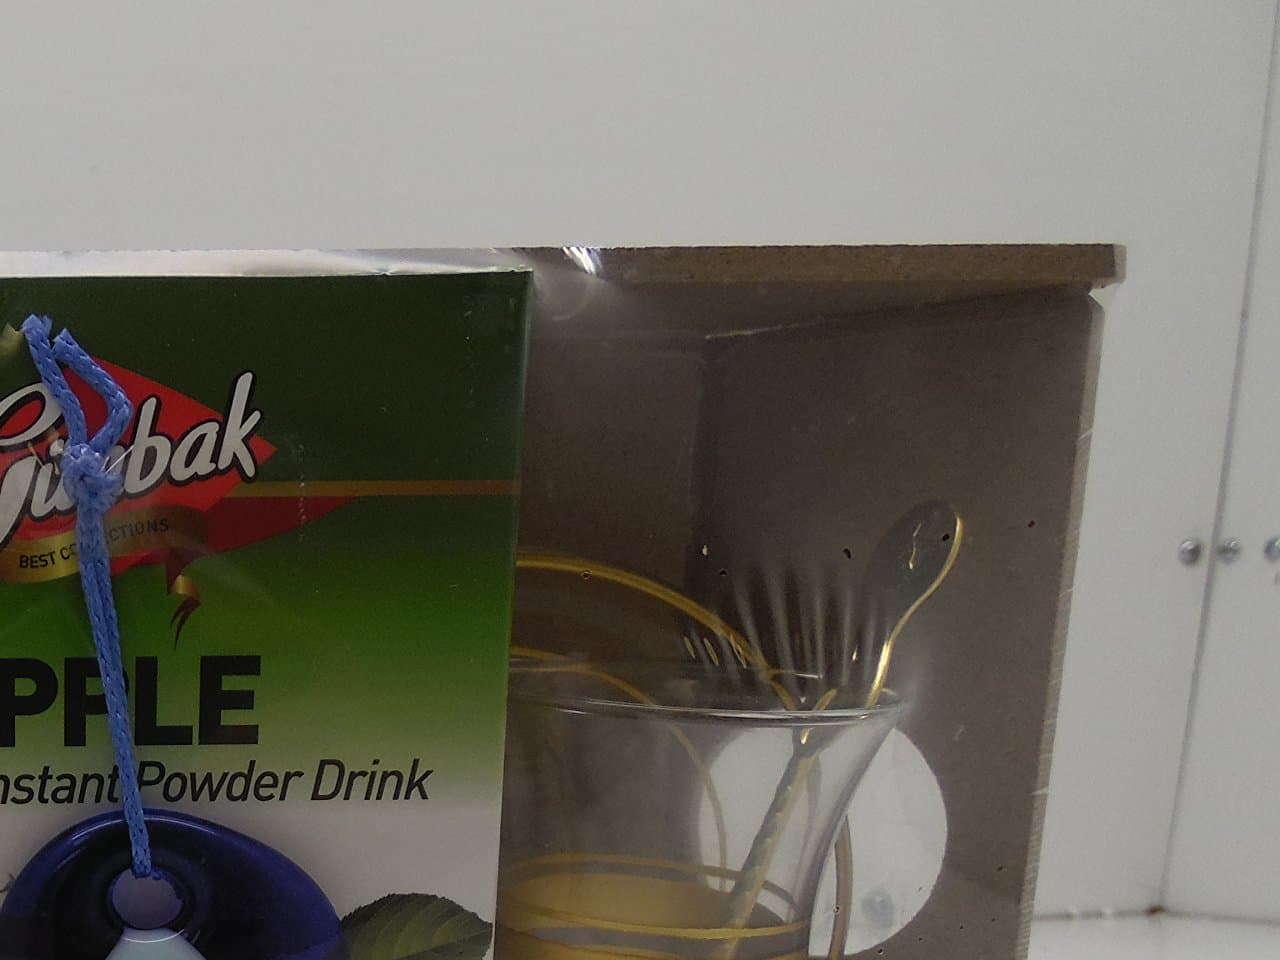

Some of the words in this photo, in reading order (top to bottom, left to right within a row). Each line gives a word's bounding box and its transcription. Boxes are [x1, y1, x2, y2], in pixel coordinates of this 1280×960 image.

[20, 551, 56, 569] BEST
[136, 759, 304, 803] Powder
[311, 758, 434, 801] Drink
